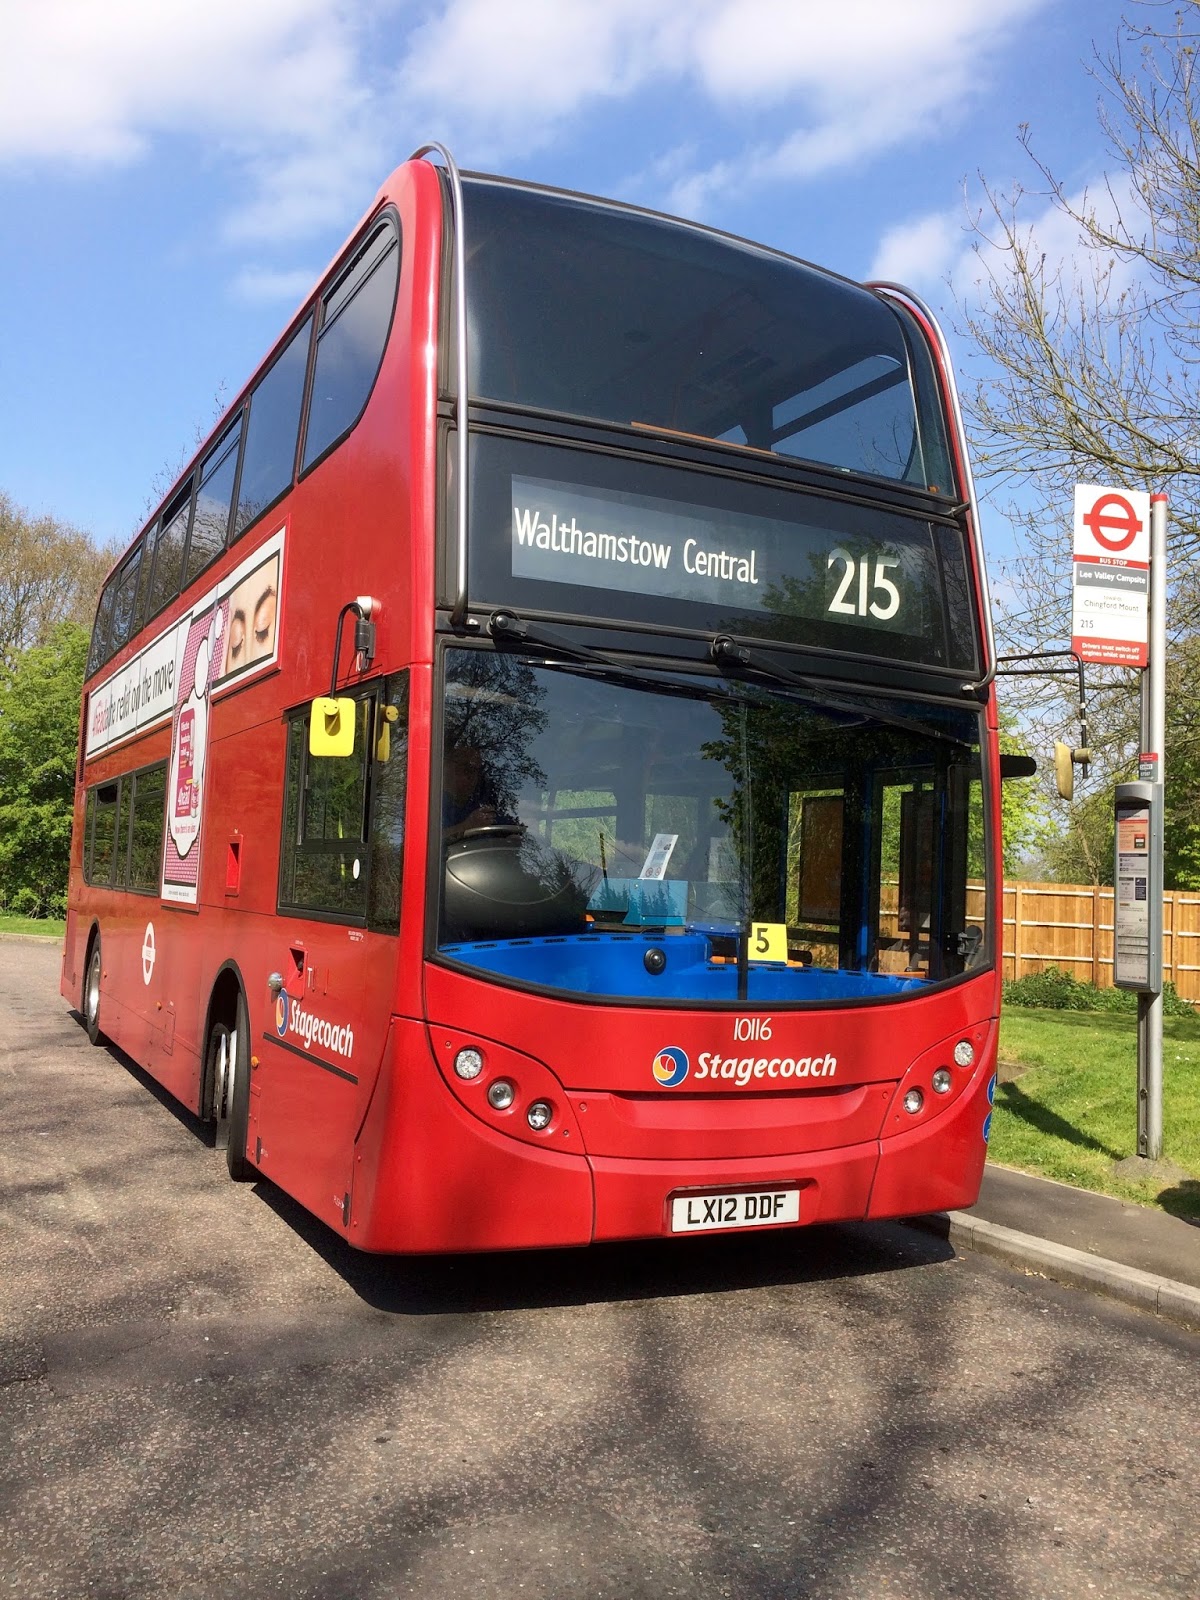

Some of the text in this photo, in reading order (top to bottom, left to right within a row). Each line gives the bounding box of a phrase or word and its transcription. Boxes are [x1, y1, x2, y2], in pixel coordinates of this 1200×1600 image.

[514, 507, 758, 585] Walthamstow Central
[1100, 557, 1128, 567] BUS STOP
[827, 547, 901, 621] 215
[1079, 570, 1146, 584] Lee Valley Campsite
[1084, 599, 1139, 612] Chingford Mount
[1080, 619, 1094, 629] 215
[141, 667, 151, 706] the
[153, 659, 174, 699] move
[755, 927, 770, 953] 5
[289, 1000, 354, 1058] Stagecoach
[733, 1017, 773, 1042] 10116
[694, 1052, 837, 1087] Stagecoach
[687, 1194, 787, 1225] LX12 DDF
